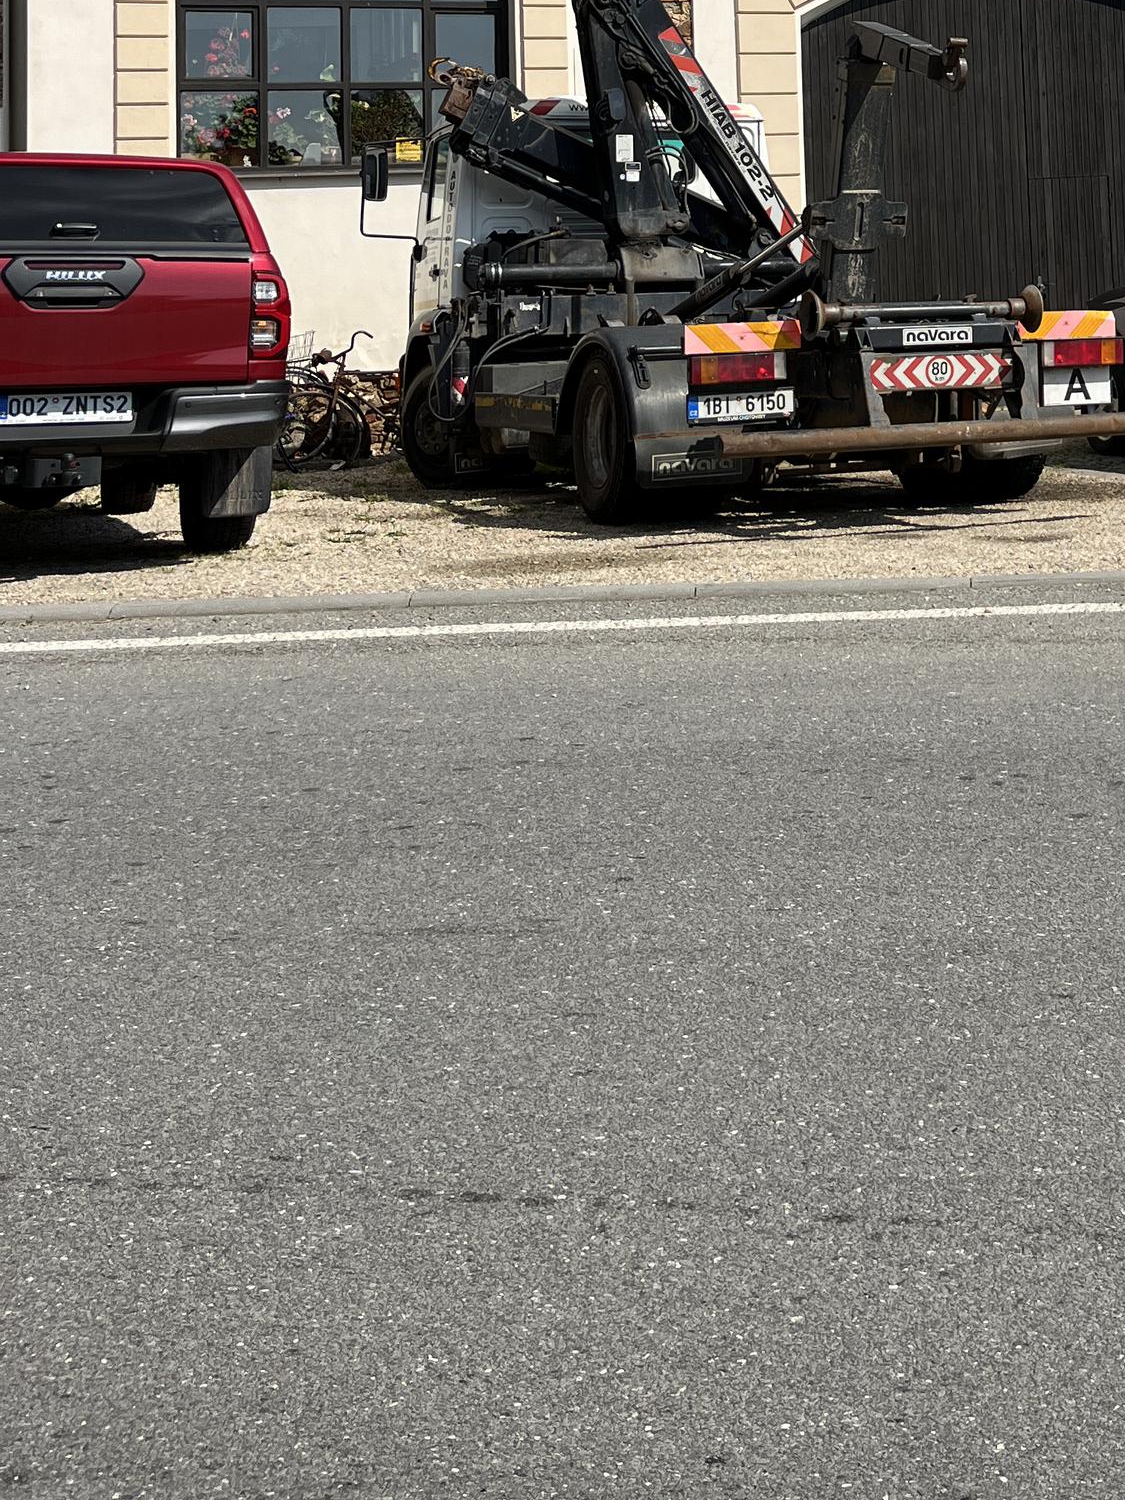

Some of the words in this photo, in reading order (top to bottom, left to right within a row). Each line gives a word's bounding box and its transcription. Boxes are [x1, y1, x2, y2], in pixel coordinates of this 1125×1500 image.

[701, 90, 737, 139] HIAB
[734, 142, 775, 201] 102-2
[46, 271, 106, 280] HILUX
[931, 361, 948, 376] 80
[1064, 368, 1091, 401] A
[9, 397, 49, 417] 002
[62, 395, 128, 415] ZNTS2
[745, 393, 786, 413] 6150
